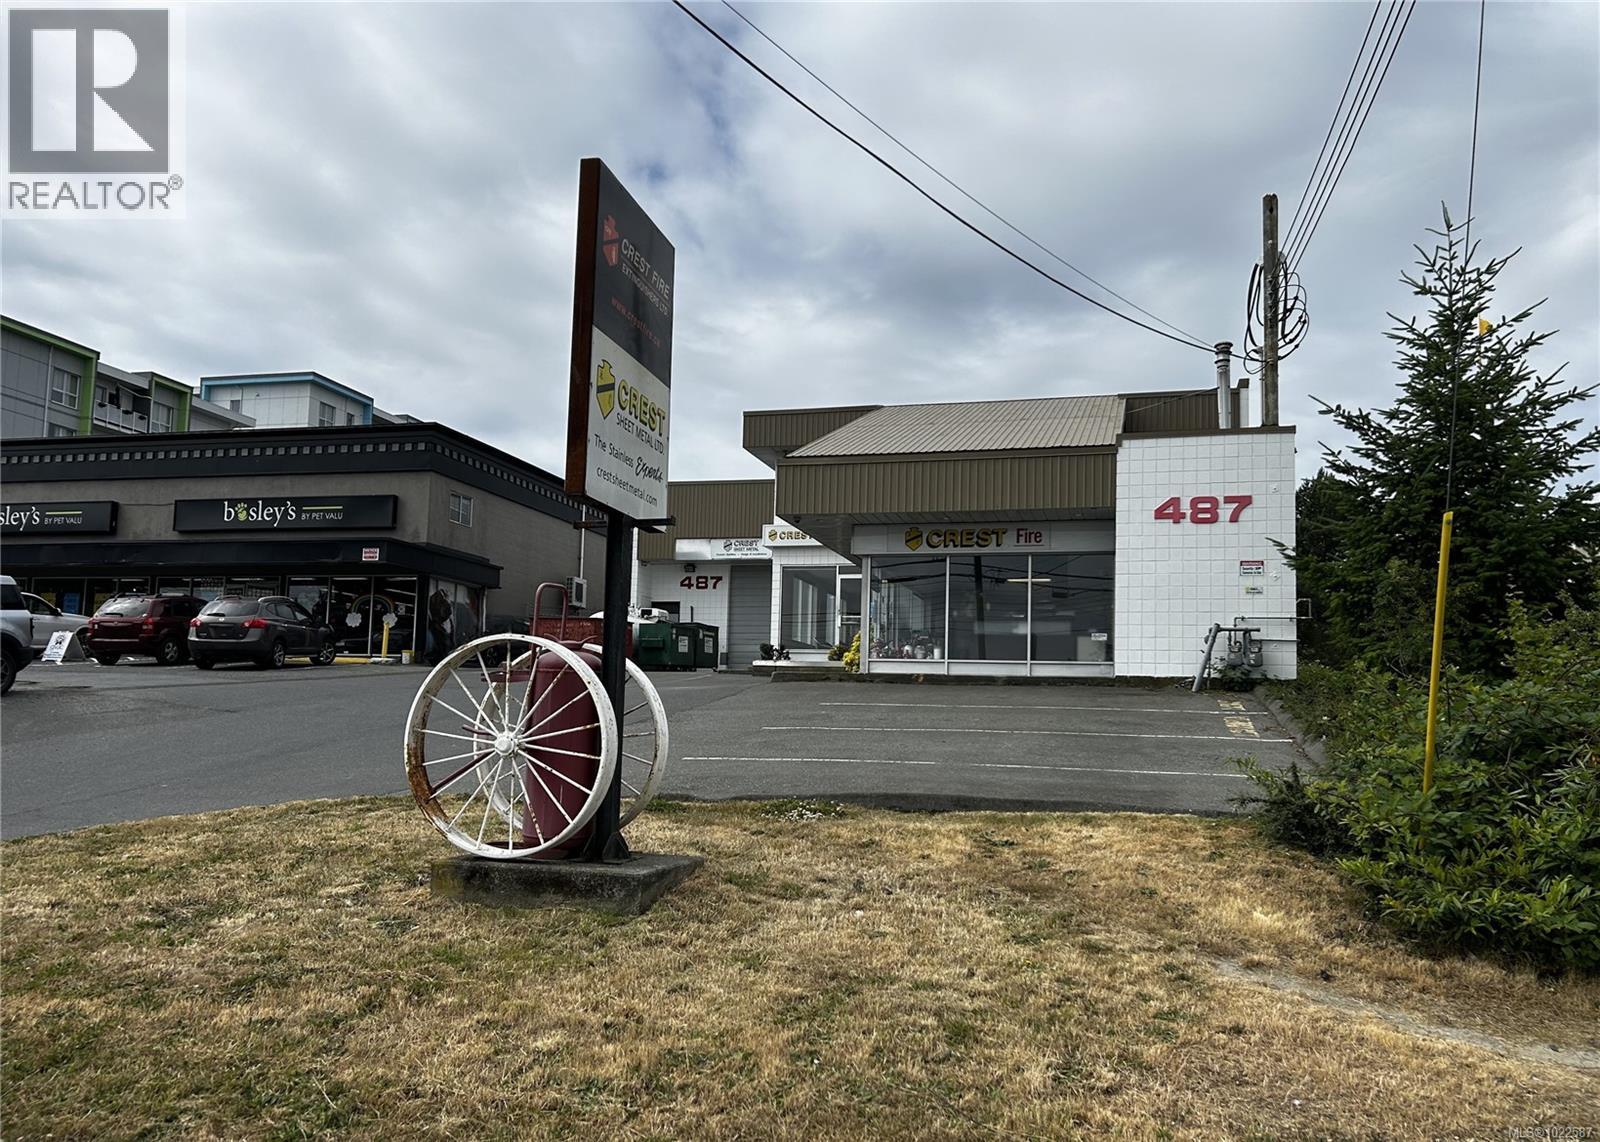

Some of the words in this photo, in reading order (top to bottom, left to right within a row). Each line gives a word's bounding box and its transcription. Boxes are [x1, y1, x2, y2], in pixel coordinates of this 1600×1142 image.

[621, 238, 651, 277] CREST
[651, 271, 671, 301] FIRE
[617, 379, 666, 437] CREST
[616, 412, 635, 434] SHEET
[635, 425, 654, 449] METAL
[594, 433, 607, 452] The
[608, 442, 634, 468] Stainless
[634, 456, 664, 483] Experts
[596, 466, 658, 507] crestsheetmetal.com
[44, 517, 52, 525] BY
[53, 517, 64, 525] PET
[65, 516, 83, 524] VALU
[311, 512, 324, 520] PET
[325, 512, 343, 520] VALU
[1153, 495, 1253, 524] 487
[733, 539, 759, 547] CREST
[925, 527, 1008, 548] CREST
[1015, 528, 1042, 544] Fire
[679, 575, 723, 590] 487
